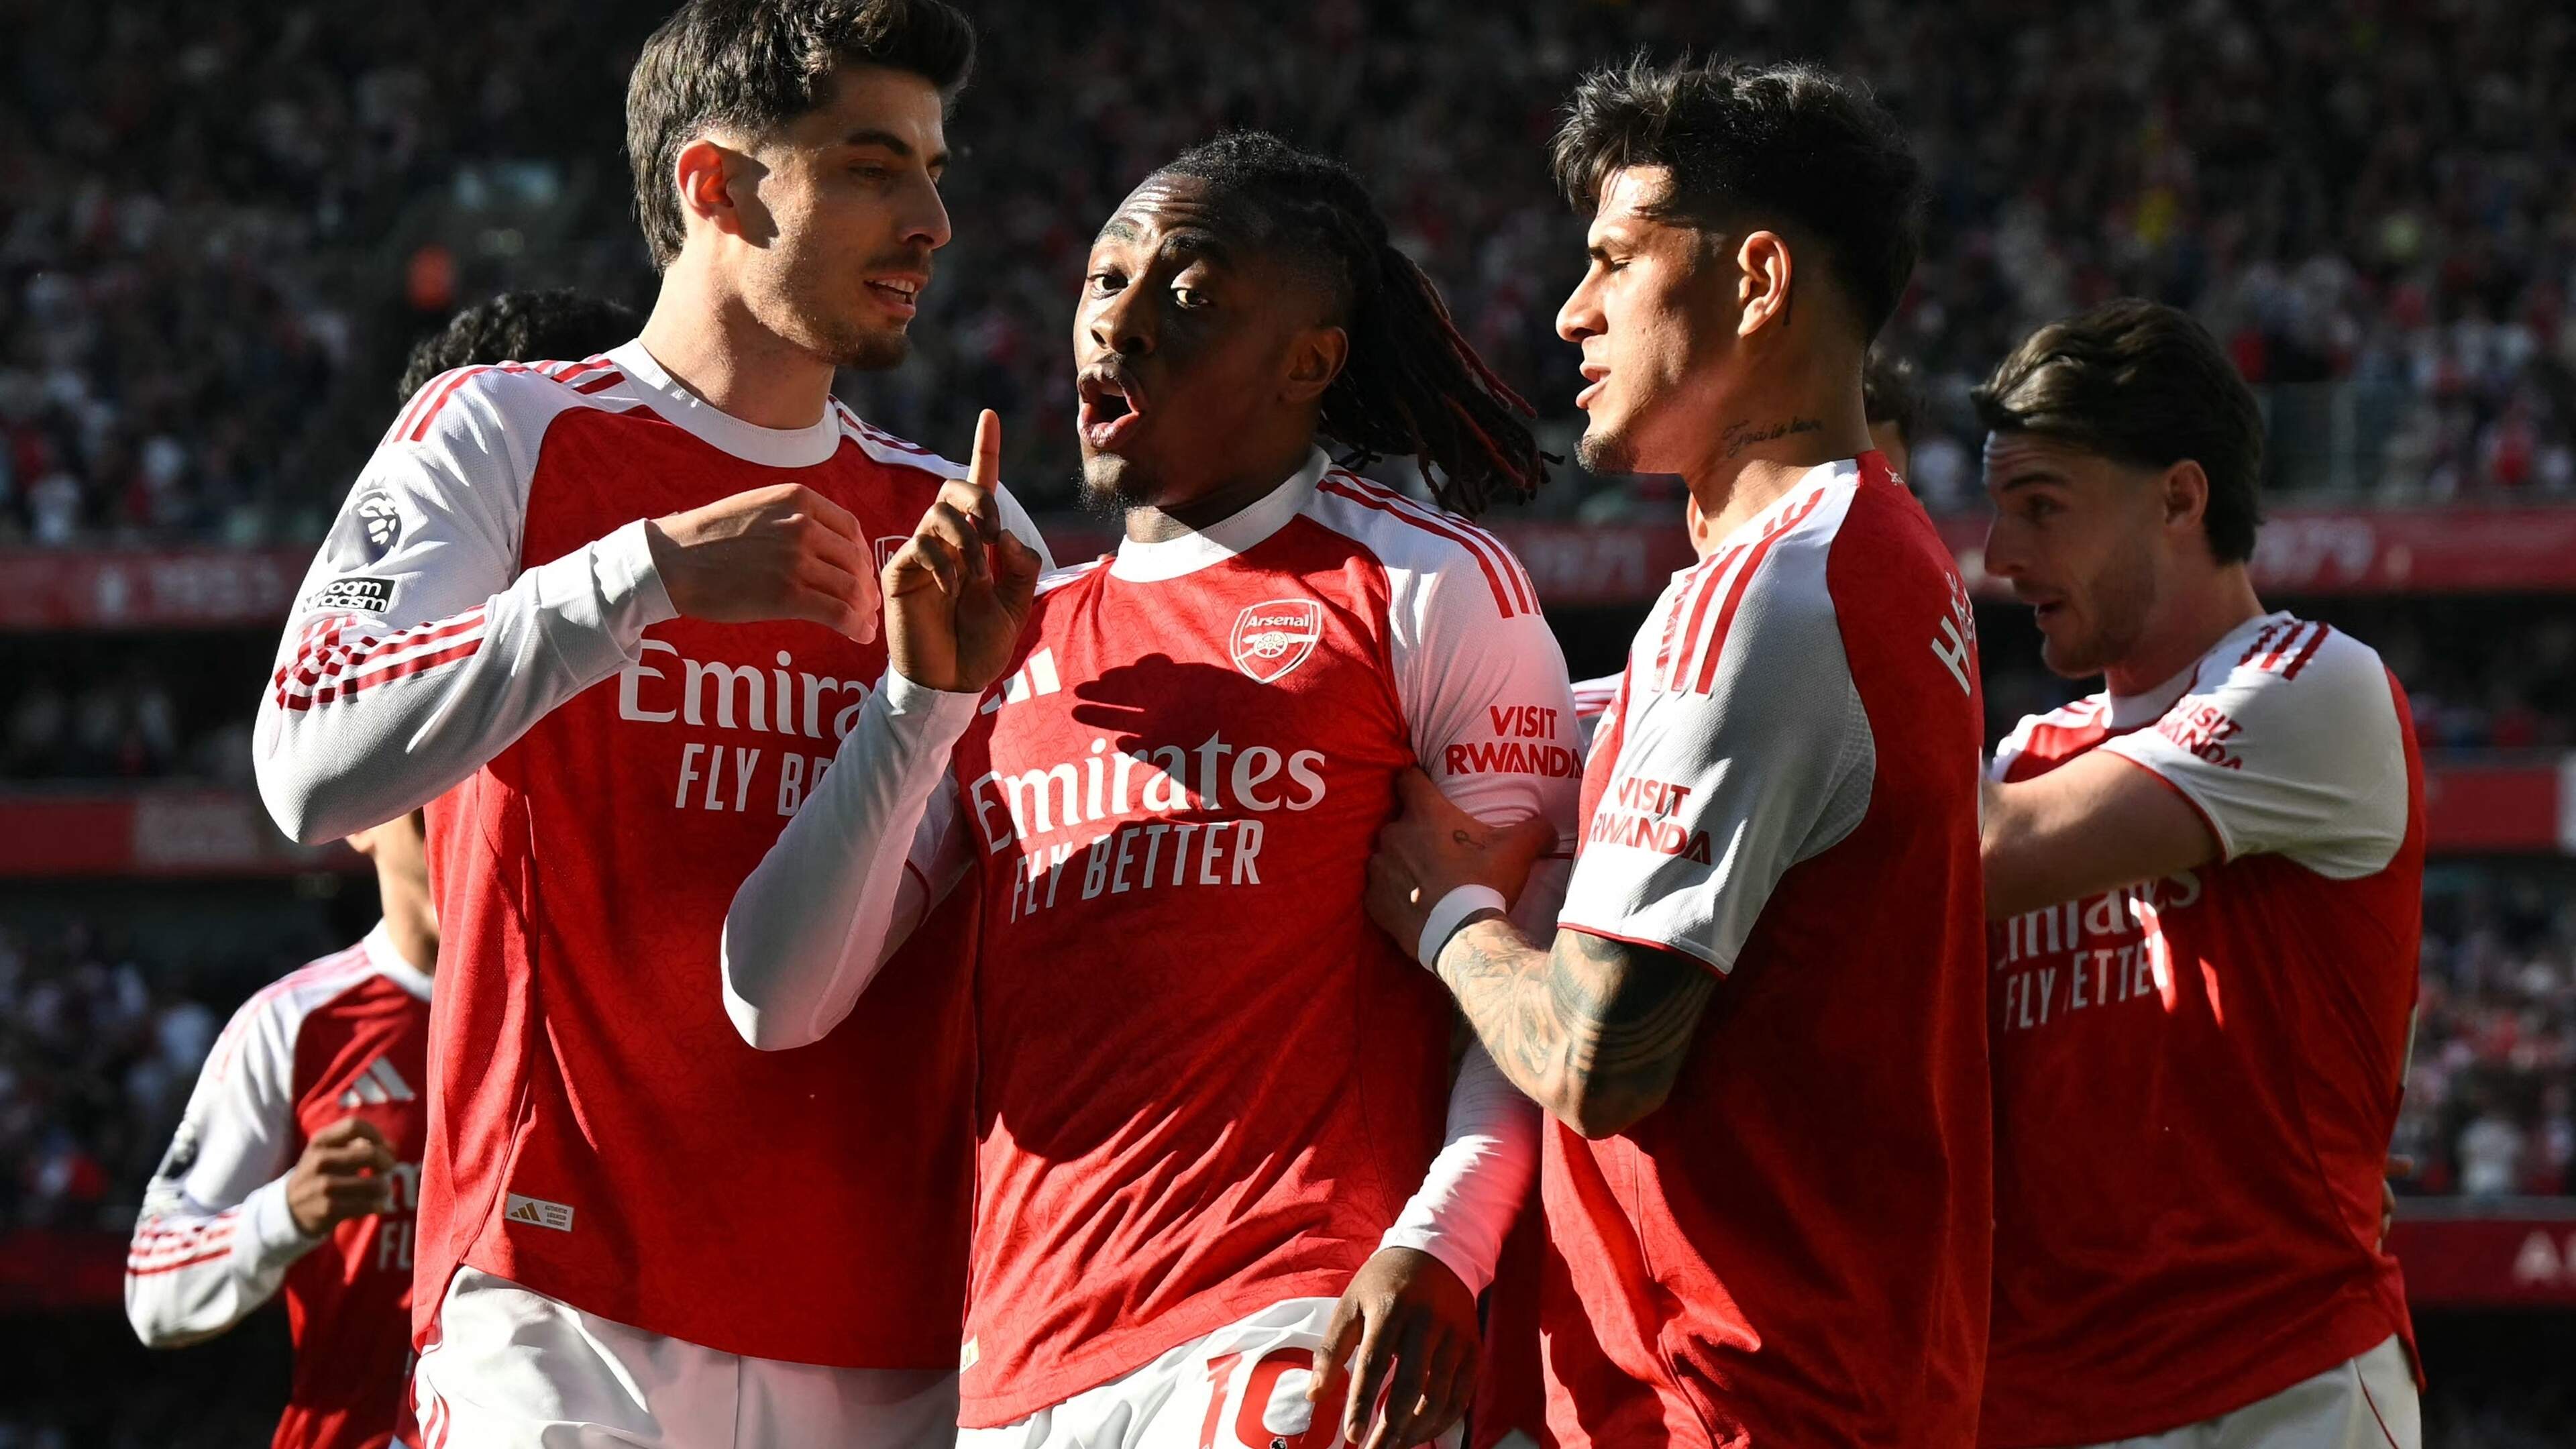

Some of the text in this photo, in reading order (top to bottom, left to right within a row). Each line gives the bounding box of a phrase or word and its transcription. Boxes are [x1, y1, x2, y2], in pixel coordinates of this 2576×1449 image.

[1245, 614, 1309, 629] Arsenal
[619, 639, 873, 741] Emira
[1490, 706, 1557, 739] VISIT
[675, 743, 761, 813] FLY
[1445, 742, 1585, 779] RWANDA
[970, 730, 1326, 855] Emirates
[1619, 777, 1691, 817] VISIT
[1591, 812, 1711, 865] RWANDA
[1011, 820, 1264, 924] FLY BETTER
[378, 1219, 414, 1271] FL
[1199, 1347, 1350, 1449] 10
